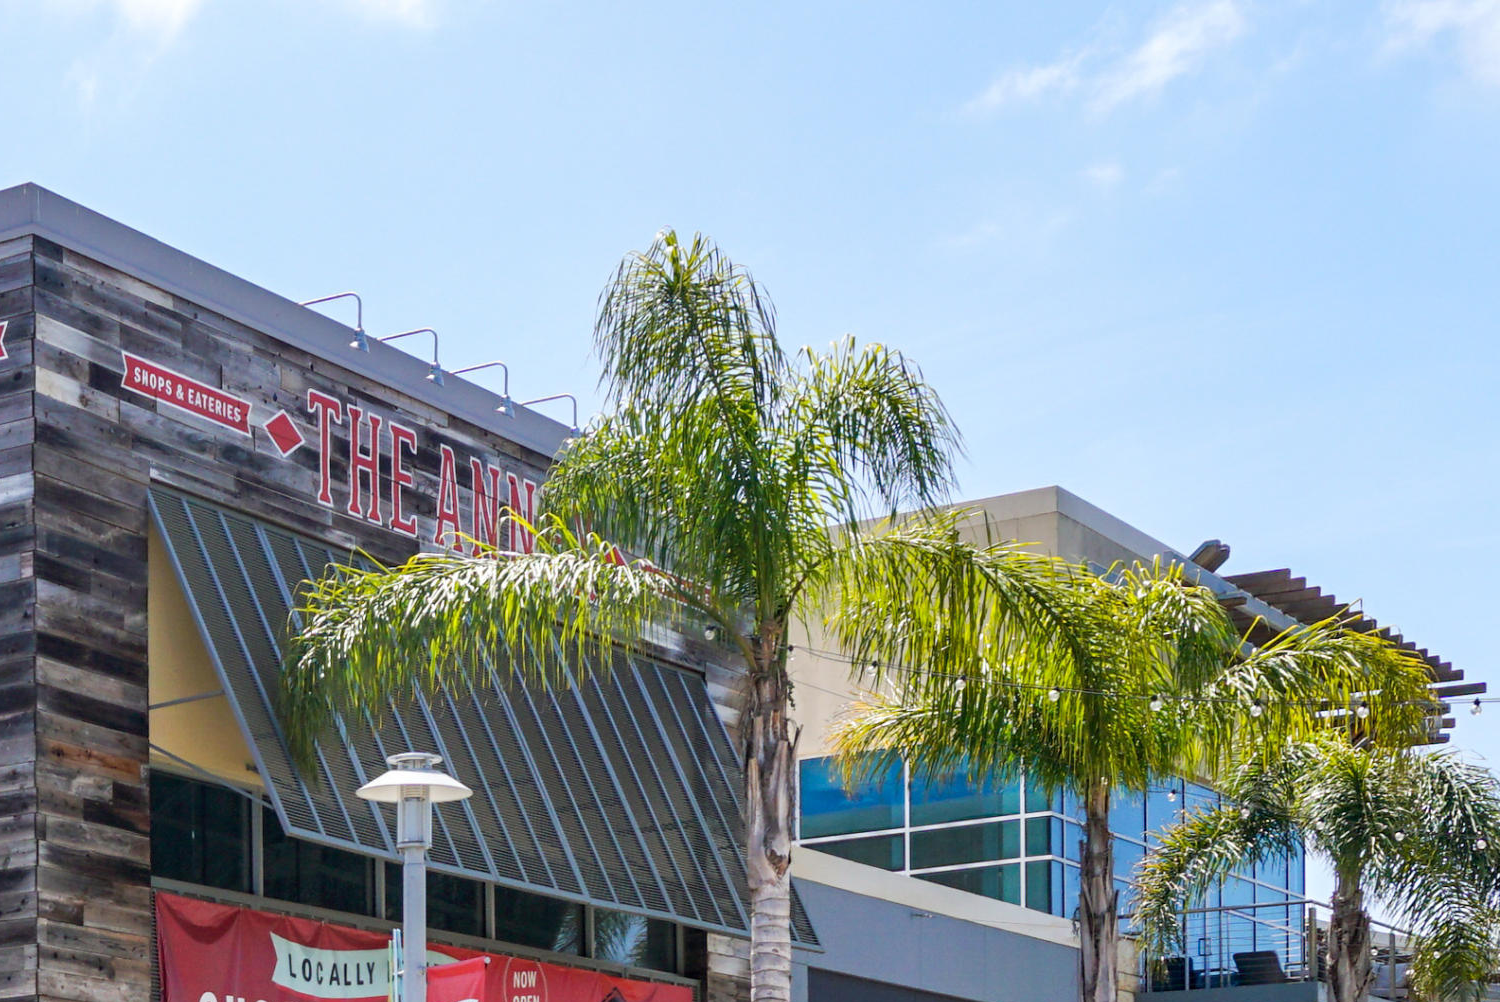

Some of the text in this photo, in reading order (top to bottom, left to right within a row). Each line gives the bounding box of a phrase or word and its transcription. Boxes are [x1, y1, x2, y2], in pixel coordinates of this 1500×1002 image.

[133, 366, 242, 423] SHOPS & EATERIES
[307, 388, 538, 560] THE ANN
[288, 954, 375, 987] LOCALLY
[513, 971, 537, 989] NOW
